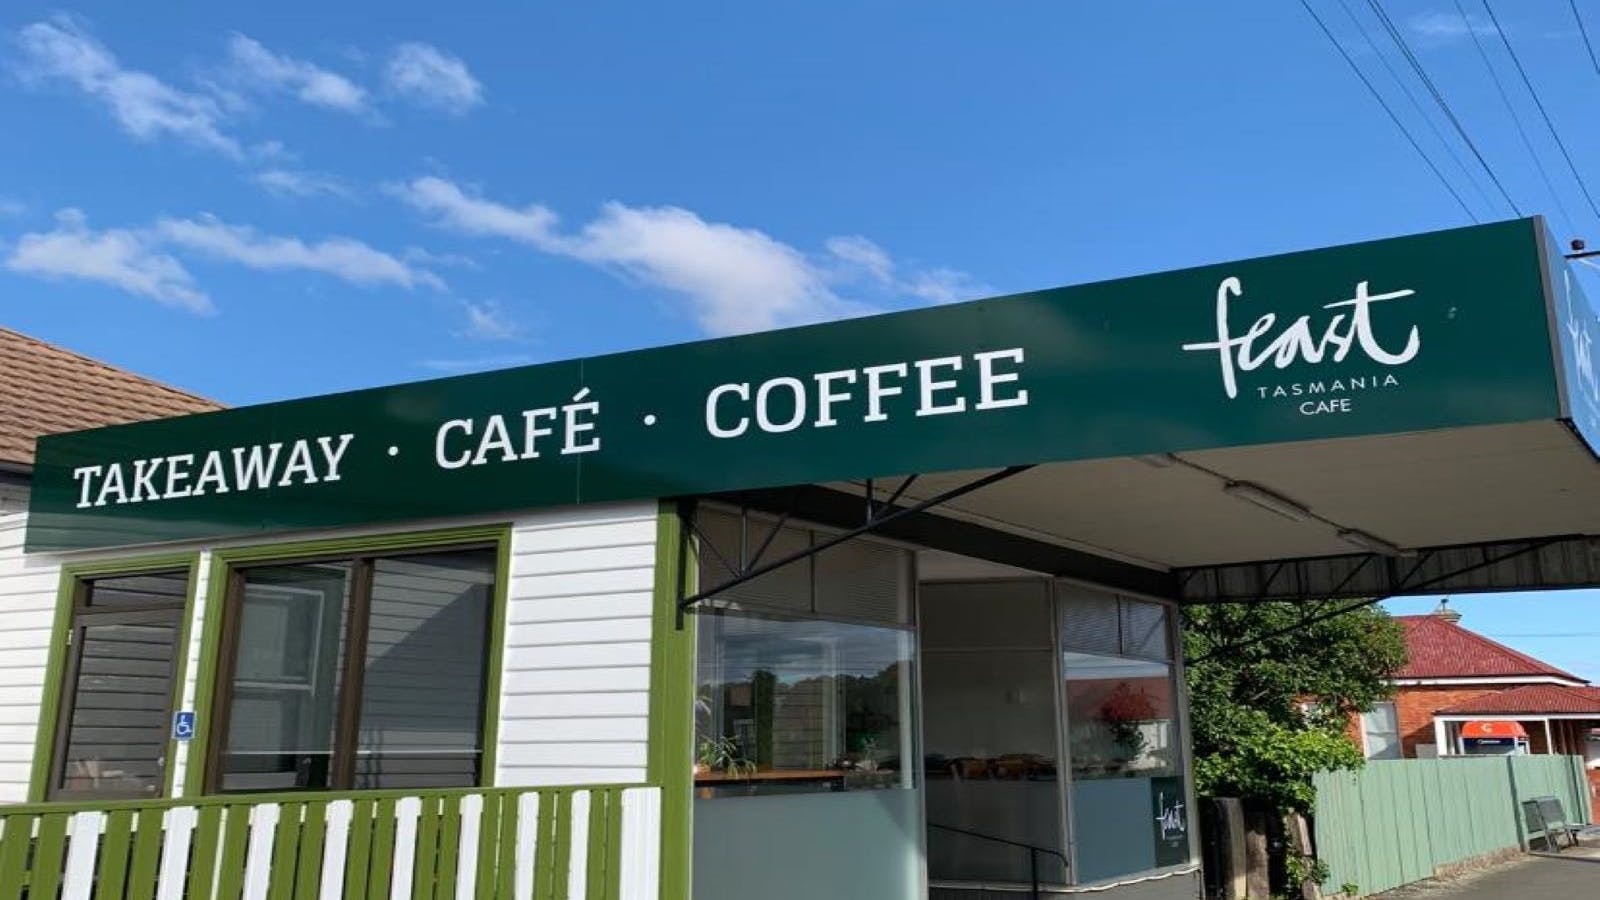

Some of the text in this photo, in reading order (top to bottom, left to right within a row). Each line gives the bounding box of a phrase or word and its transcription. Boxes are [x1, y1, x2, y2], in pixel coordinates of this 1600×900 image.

[1183, 277, 1420, 399] feast
[1257, 374, 1399, 399] TASMANIA
[1299, 398, 1352, 417] CAFE
[74, 347, 1029, 509] TAKEAWAY CAFÉ COFFEE
